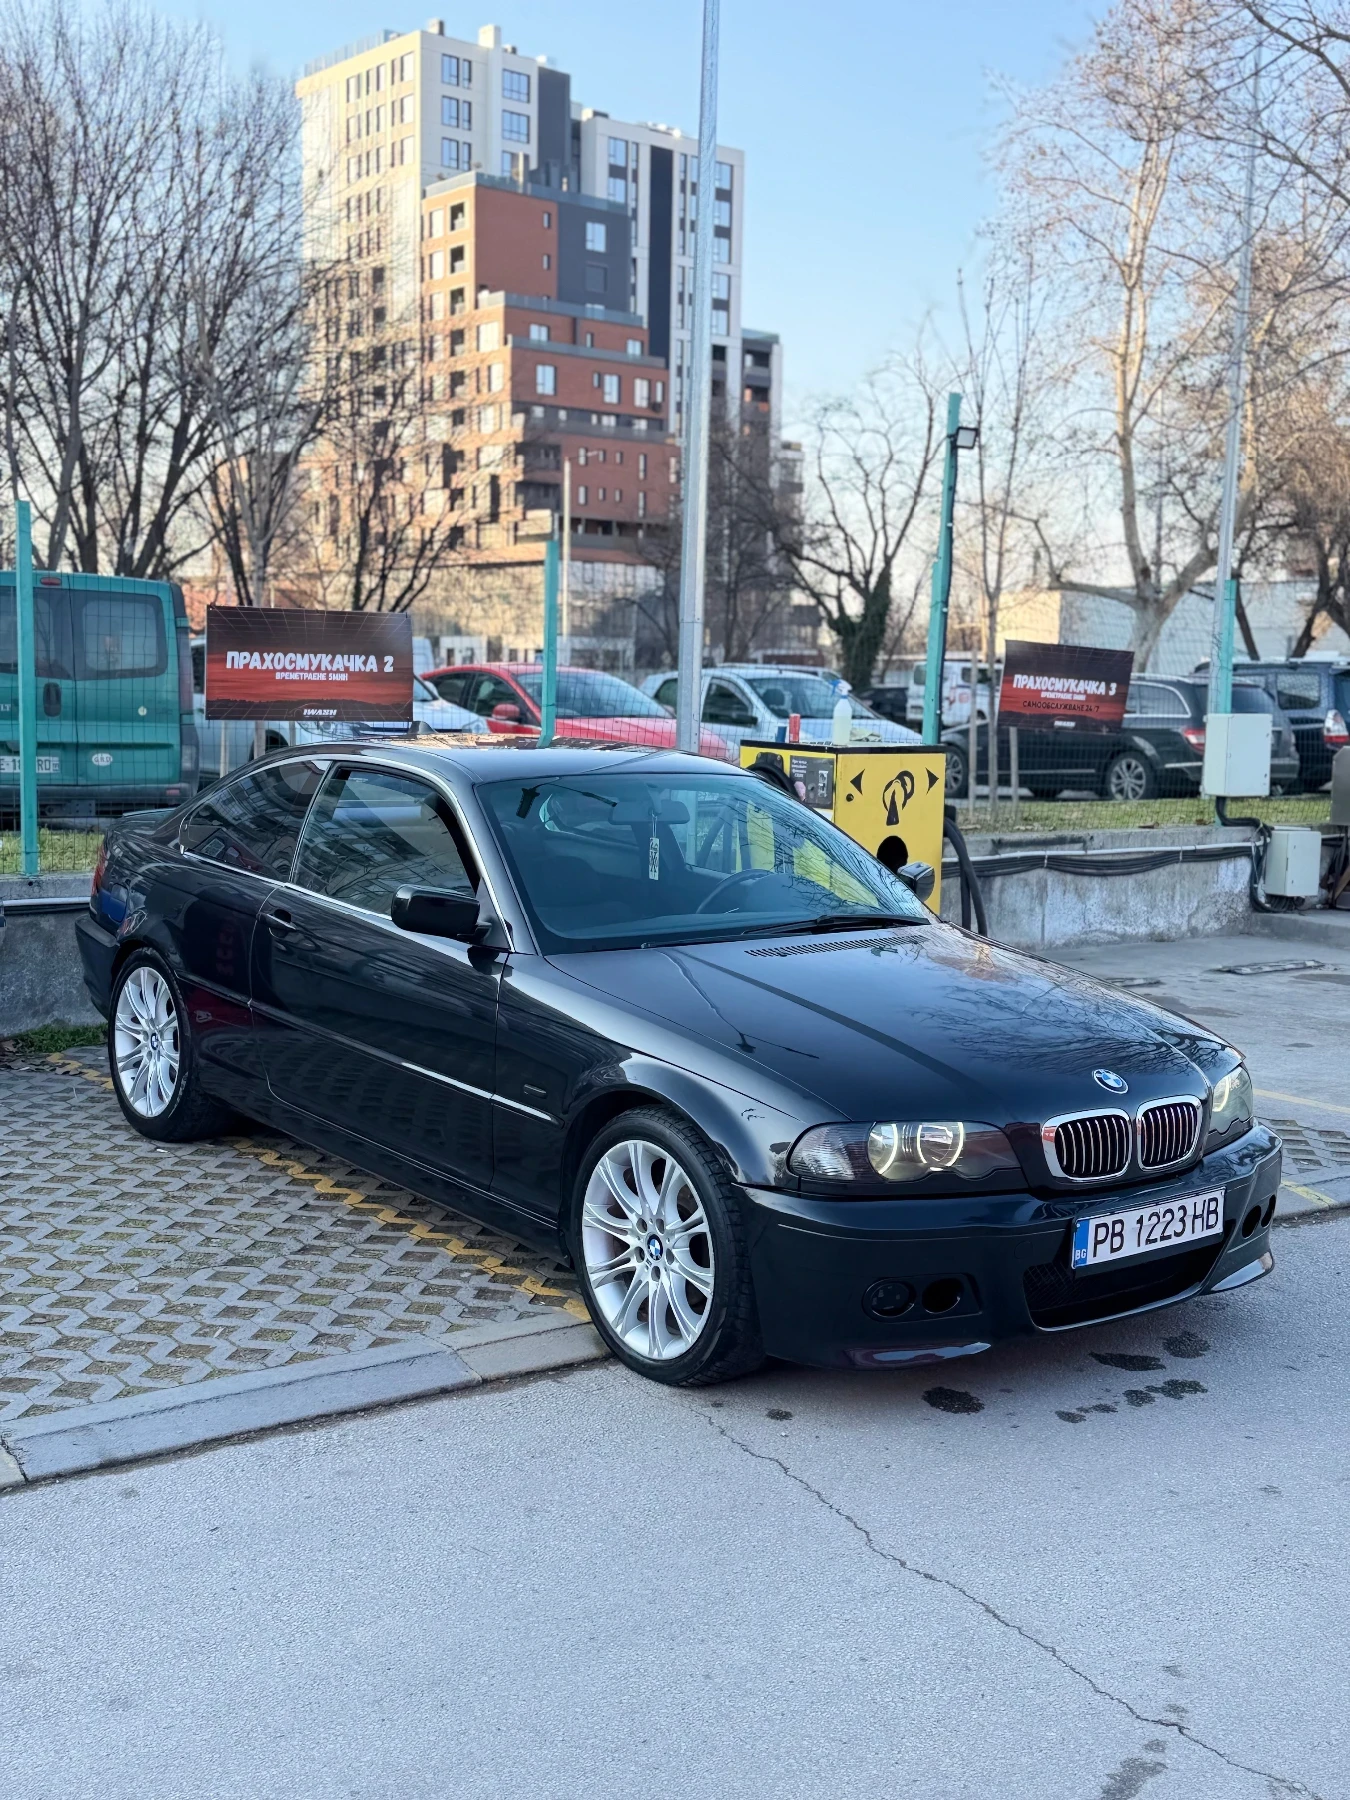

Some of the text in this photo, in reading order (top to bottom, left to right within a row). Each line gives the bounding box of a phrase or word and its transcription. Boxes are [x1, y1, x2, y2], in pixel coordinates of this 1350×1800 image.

[226, 651, 394, 672] ПРАХОСМУКАЧКА 2
[275, 672, 326, 680] ВРЕМЕТРАЕНЕ
[1013, 674, 1117, 696] ПРАХОСМУКАЧКА 3
[1092, 1196, 1219, 1258] PB 1223 HB
[1074, 1248, 1087, 1261] BG
